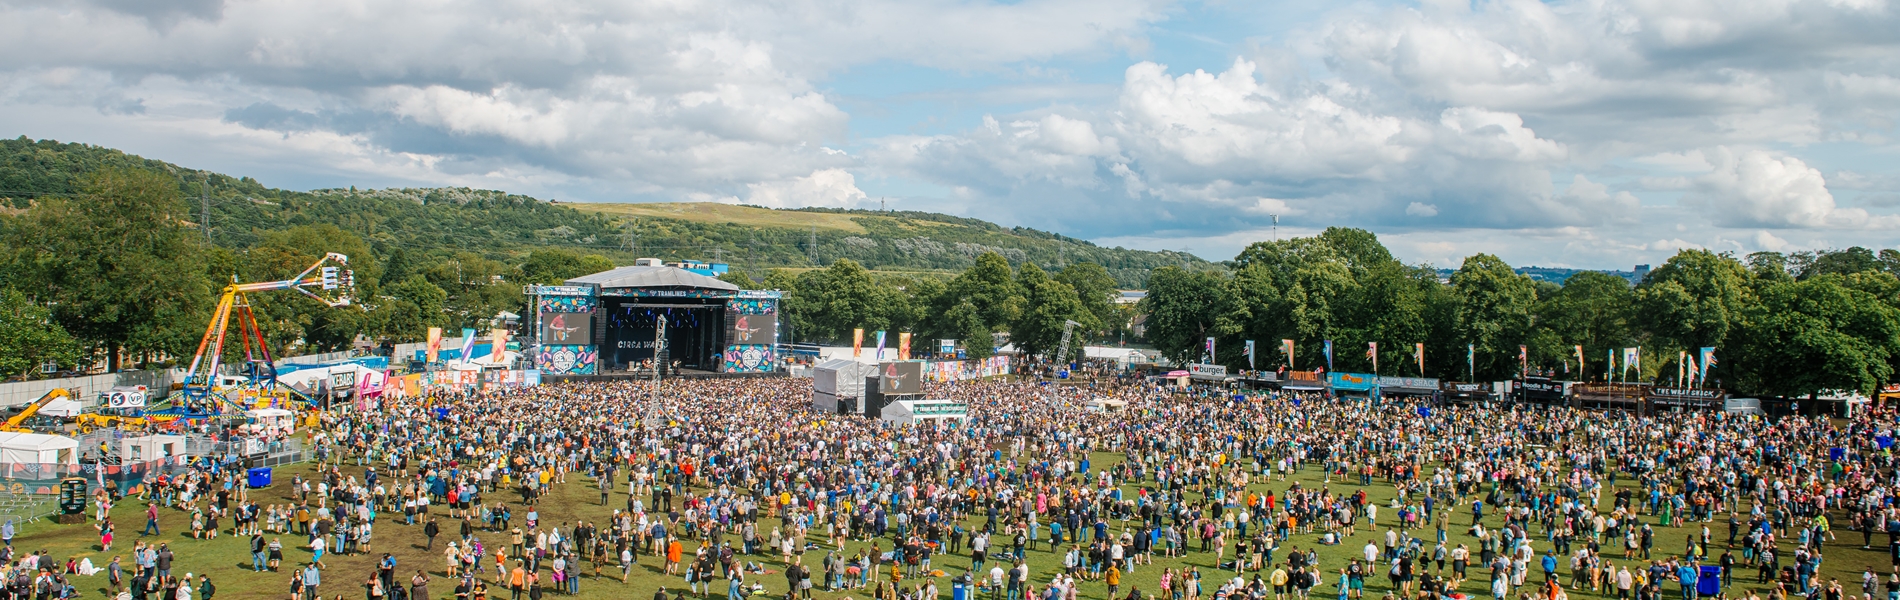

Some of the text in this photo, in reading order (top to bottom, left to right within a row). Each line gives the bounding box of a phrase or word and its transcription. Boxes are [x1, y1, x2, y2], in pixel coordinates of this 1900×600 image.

[617, 340, 641, 349] CIRCA
[333, 373, 354, 387] KEBABS
[1381, 378, 1438, 388] PIZZA SHACK
